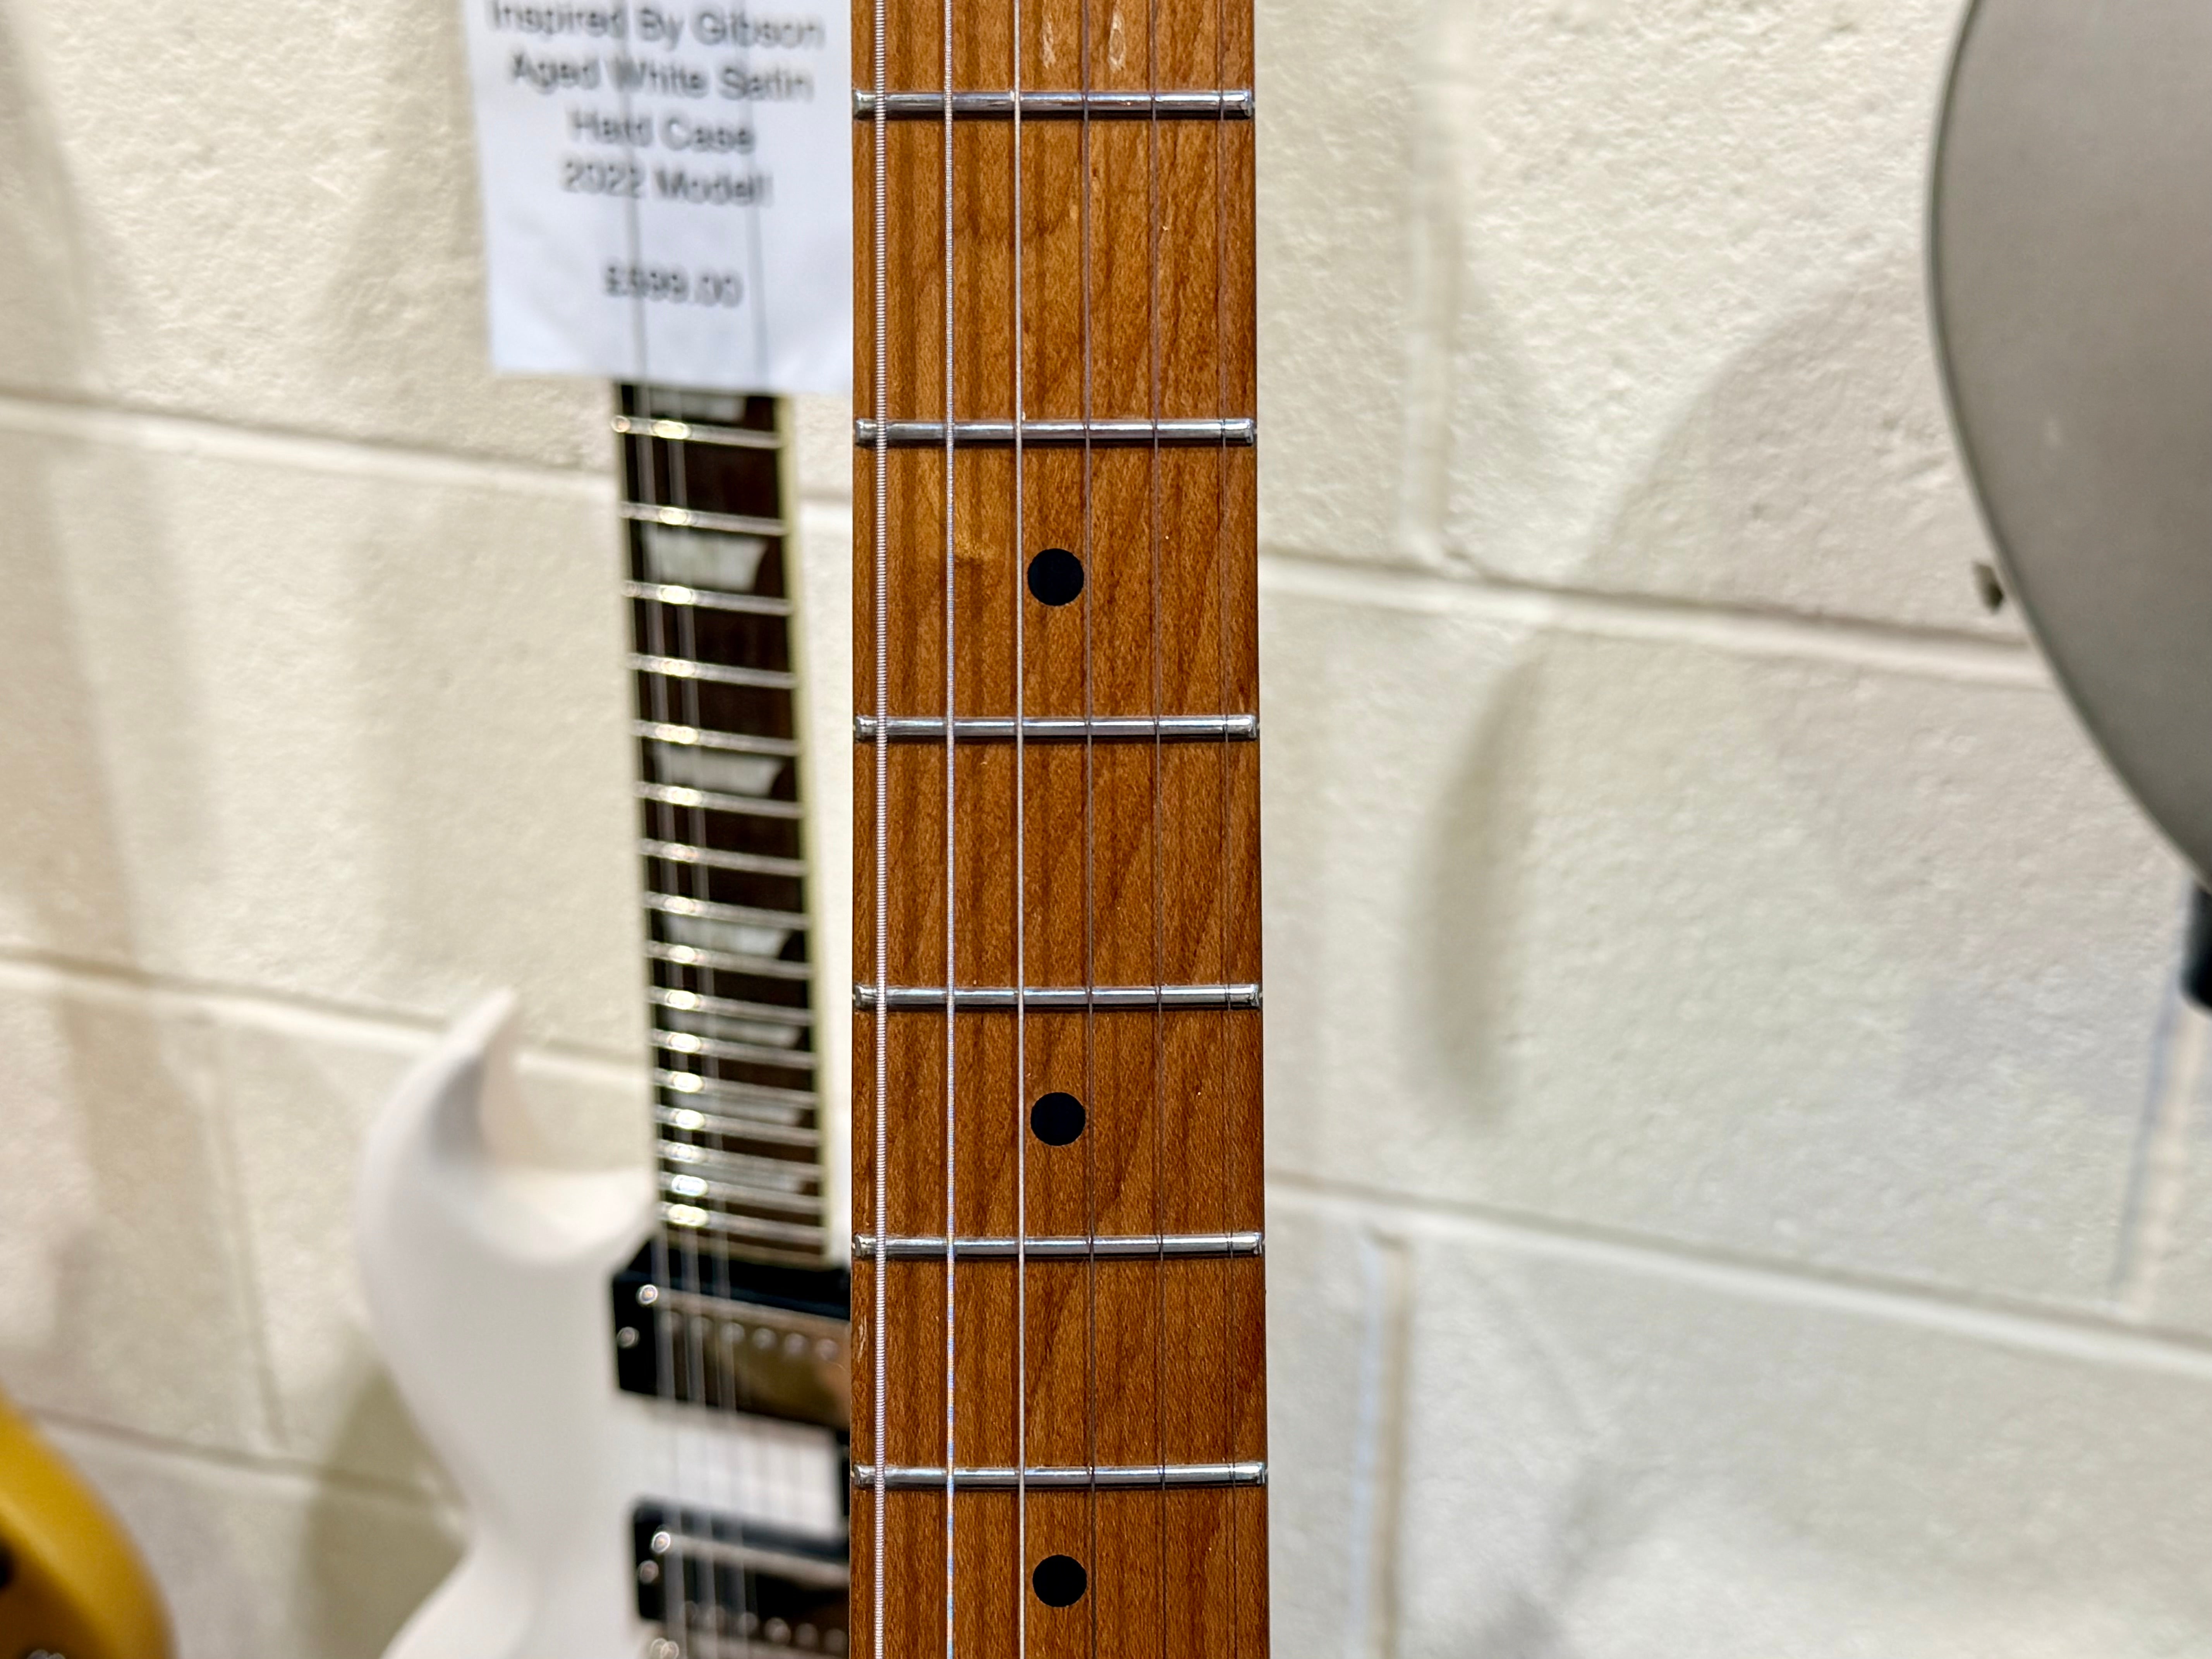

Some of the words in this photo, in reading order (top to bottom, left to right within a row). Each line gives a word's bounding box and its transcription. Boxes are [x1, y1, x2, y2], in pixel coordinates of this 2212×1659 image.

[487, 0, 627, 40] Inspired
[635, 5, 684, 50] By
[692, 6, 826, 49] Gibson
[507, 47, 601, 94] Aged
[604, 57, 709, 98] White
[717, 60, 814, 102] Satin
[567, 106, 653, 148] Hard
[659, 112, 756, 153] Case
[561, 156, 646, 198] 2022
